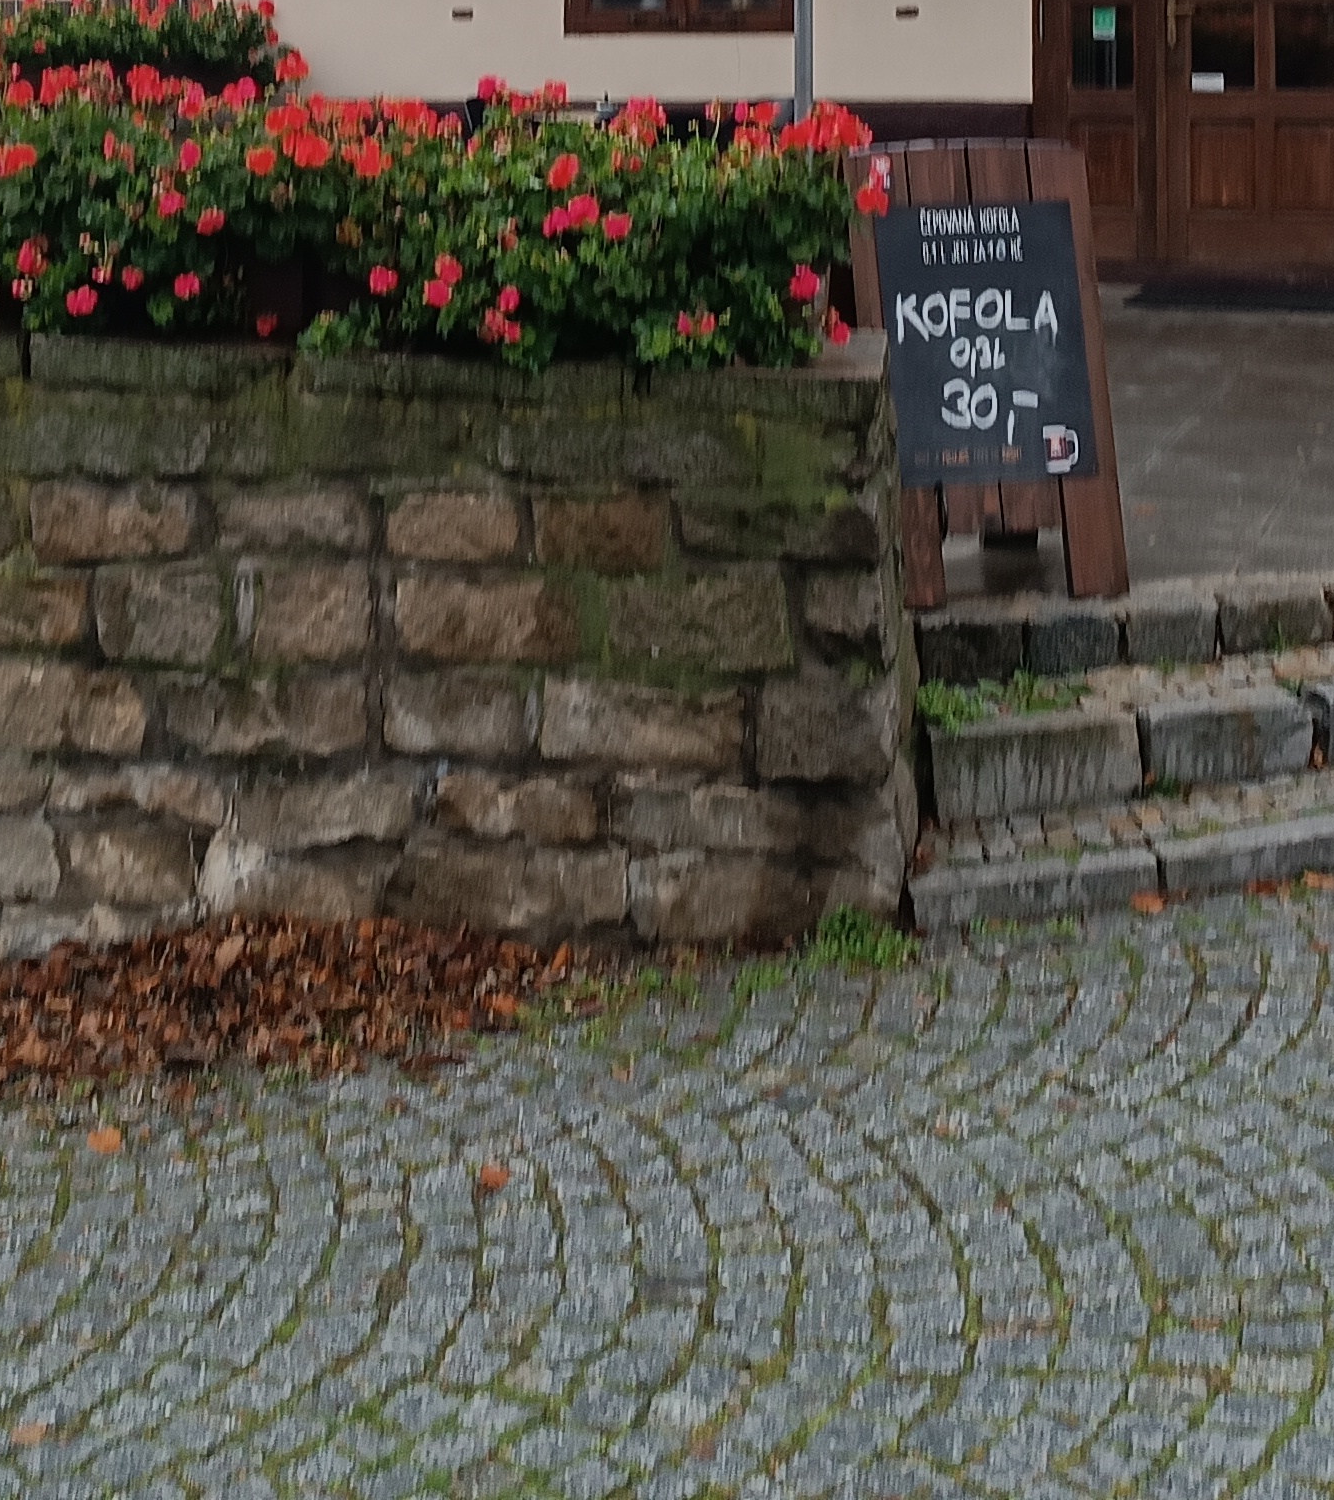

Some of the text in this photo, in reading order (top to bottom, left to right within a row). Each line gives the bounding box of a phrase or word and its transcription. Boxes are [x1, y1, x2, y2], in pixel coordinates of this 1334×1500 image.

[919, 205, 1020, 237] ČEPOVANÁ KOFOLA
[951, 239, 969, 265] JEN
[895, 286, 1058, 347] KOFOLA
